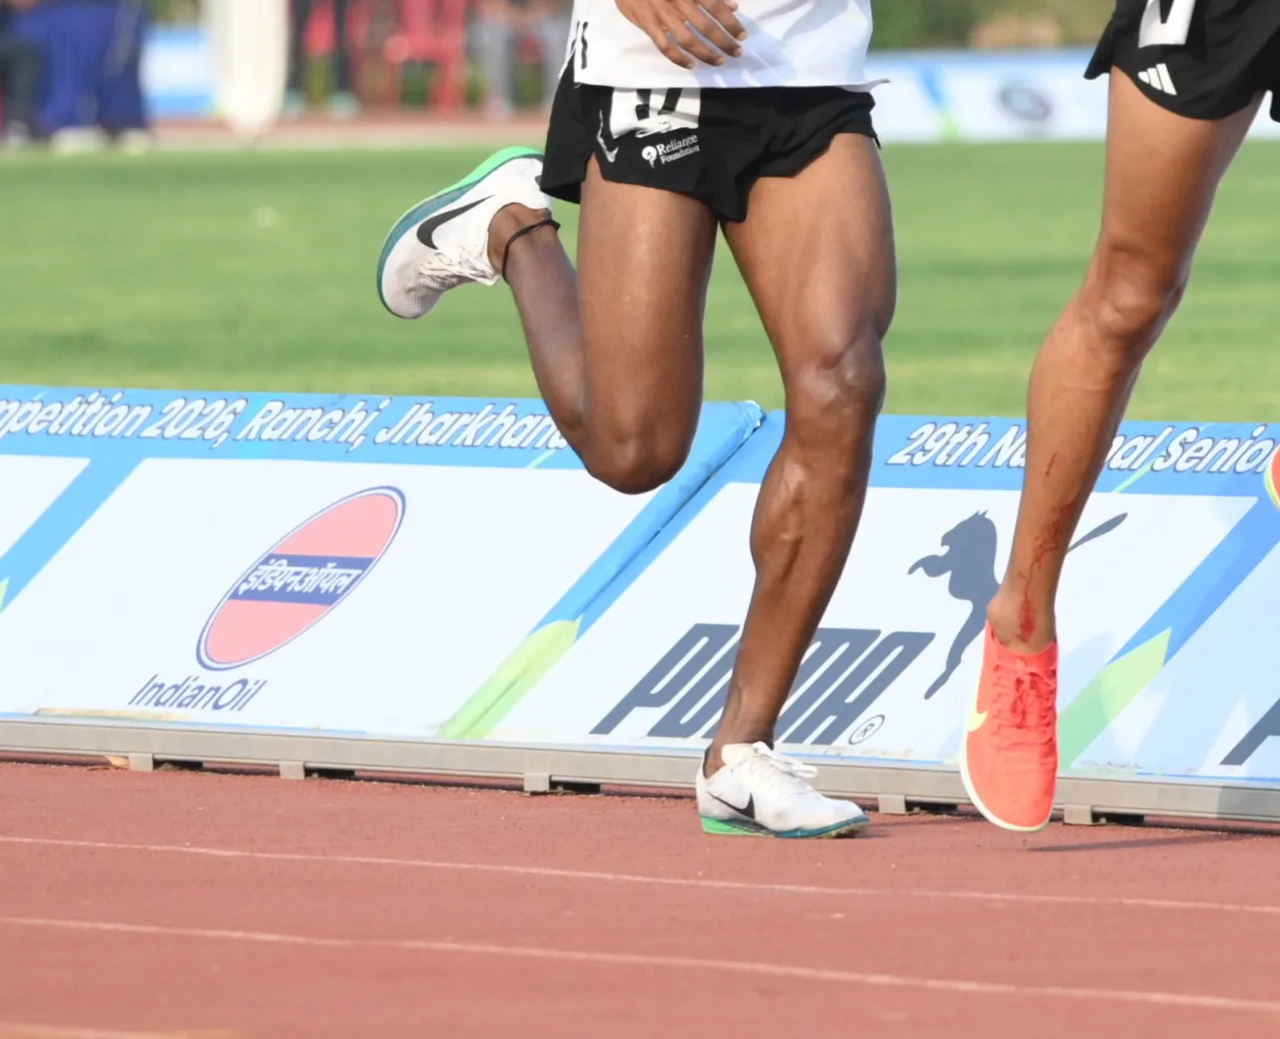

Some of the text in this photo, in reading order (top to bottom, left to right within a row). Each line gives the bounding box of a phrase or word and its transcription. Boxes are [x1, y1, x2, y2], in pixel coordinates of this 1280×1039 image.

[655, 134, 699, 156] Reliance
[659, 145, 701, 164] Foundation
[0, 390, 152, 440] petition
[138, 396, 248, 450] 2026,
[235, 396, 393, 453] Ranchi,
[886, 421, 993, 468] 29th
[1150, 423, 1279, 474] Senio
[127, 674, 268, 712] IndianOil
